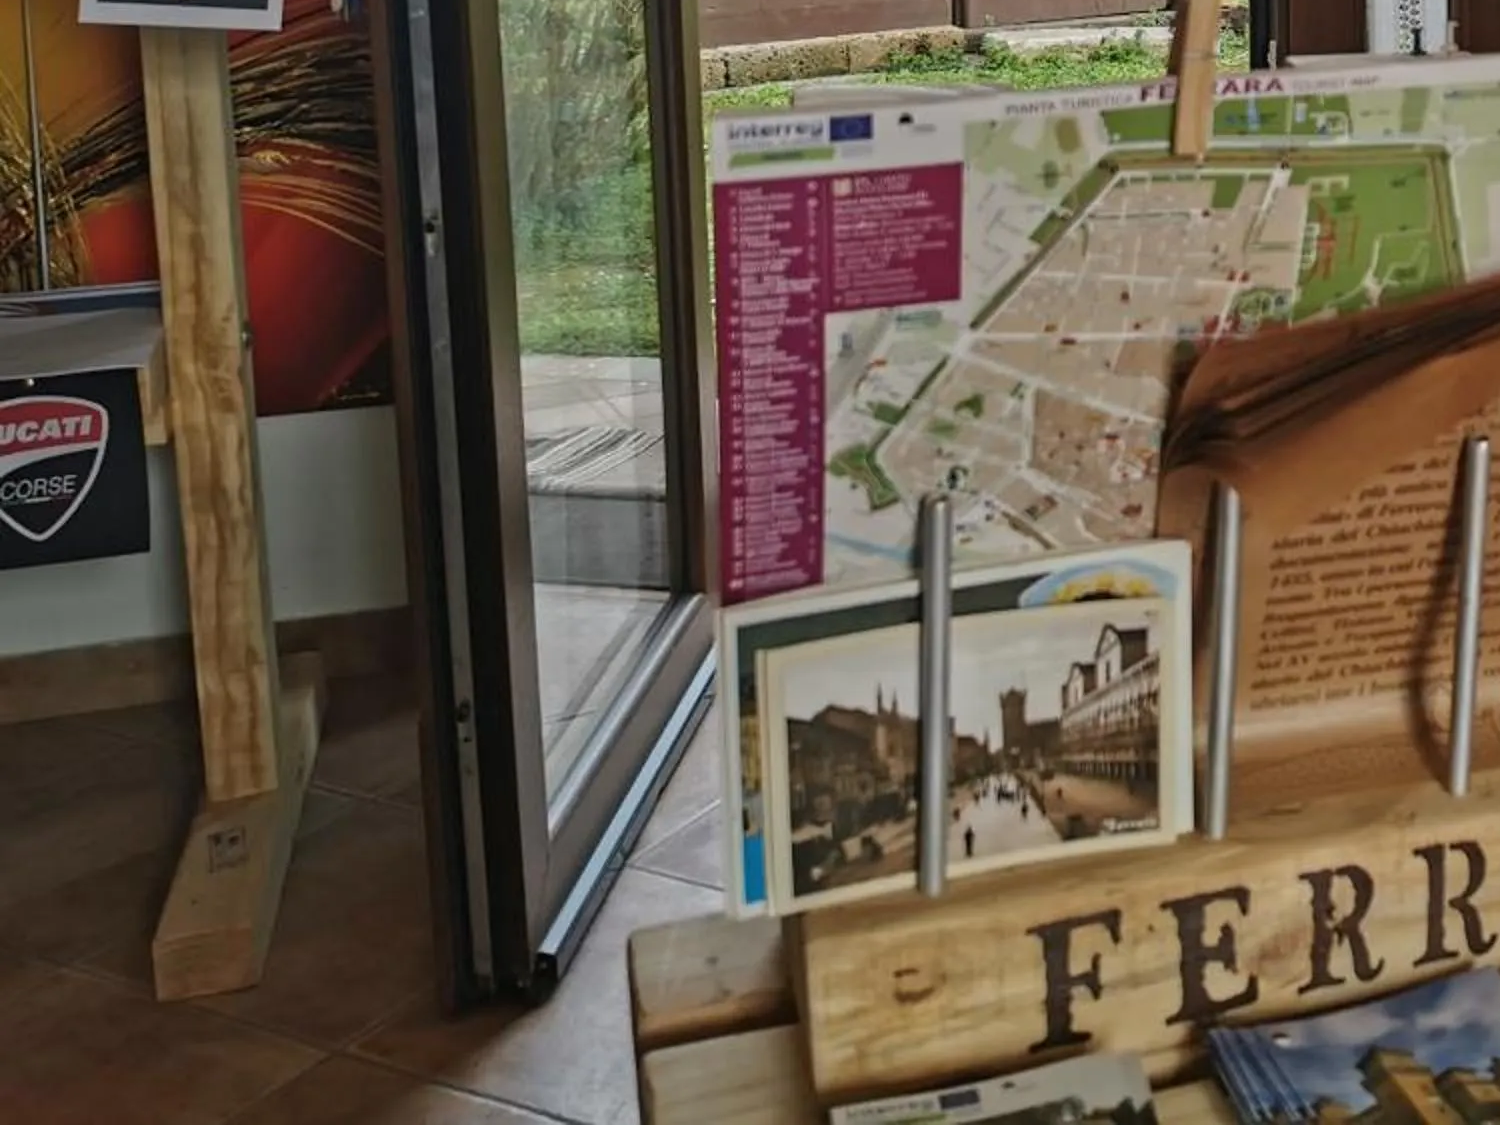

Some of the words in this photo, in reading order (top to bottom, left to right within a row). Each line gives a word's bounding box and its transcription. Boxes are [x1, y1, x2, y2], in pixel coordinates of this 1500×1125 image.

[1140, 77, 1284, 102] FEARA
[0, 414, 93, 445] UCATI
[0, 475, 77, 501] CORSE
